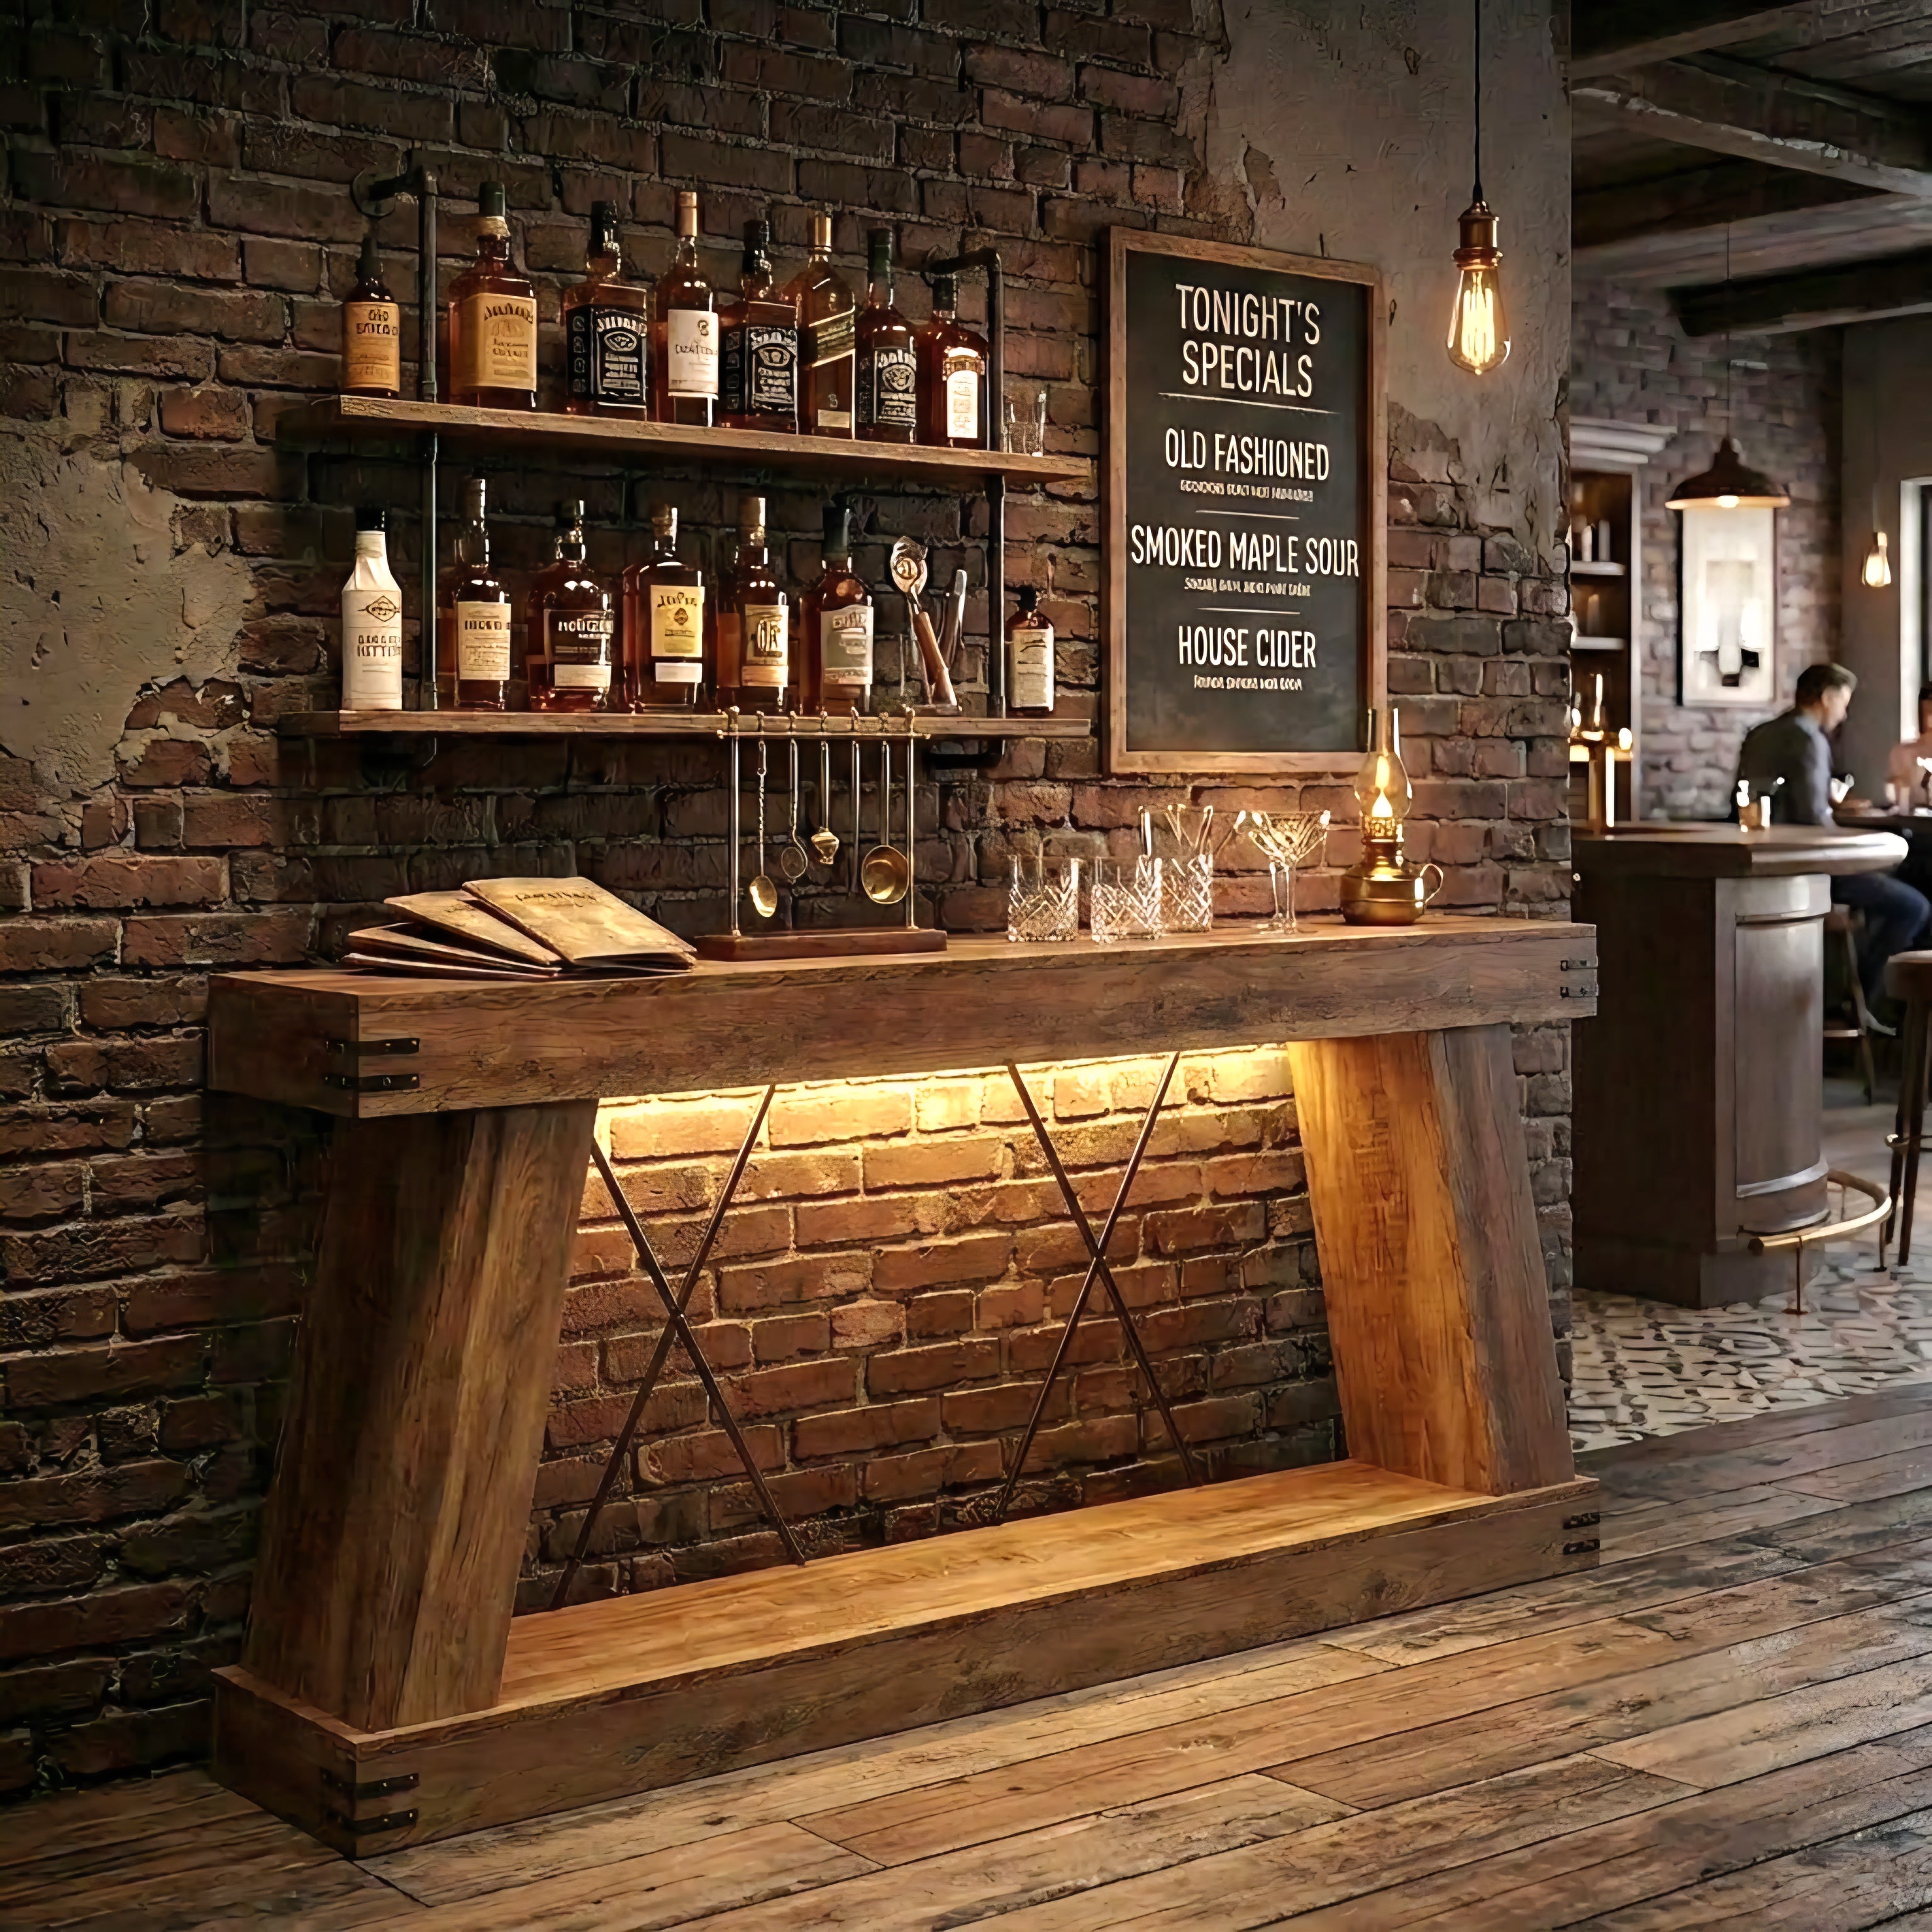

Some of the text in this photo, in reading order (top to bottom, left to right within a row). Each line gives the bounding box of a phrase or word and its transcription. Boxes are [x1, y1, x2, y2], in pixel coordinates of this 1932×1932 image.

[1175, 283, 1320, 345] TONIGHT'S
[1182, 340, 1313, 397] SPECIALS
[1165, 427, 1330, 481] OLD FASHIONED
[1130, 525, 1360, 577] SMOKED MAPLE SOUR
[1178, 625, 1317, 669] HOUSE CIDER
